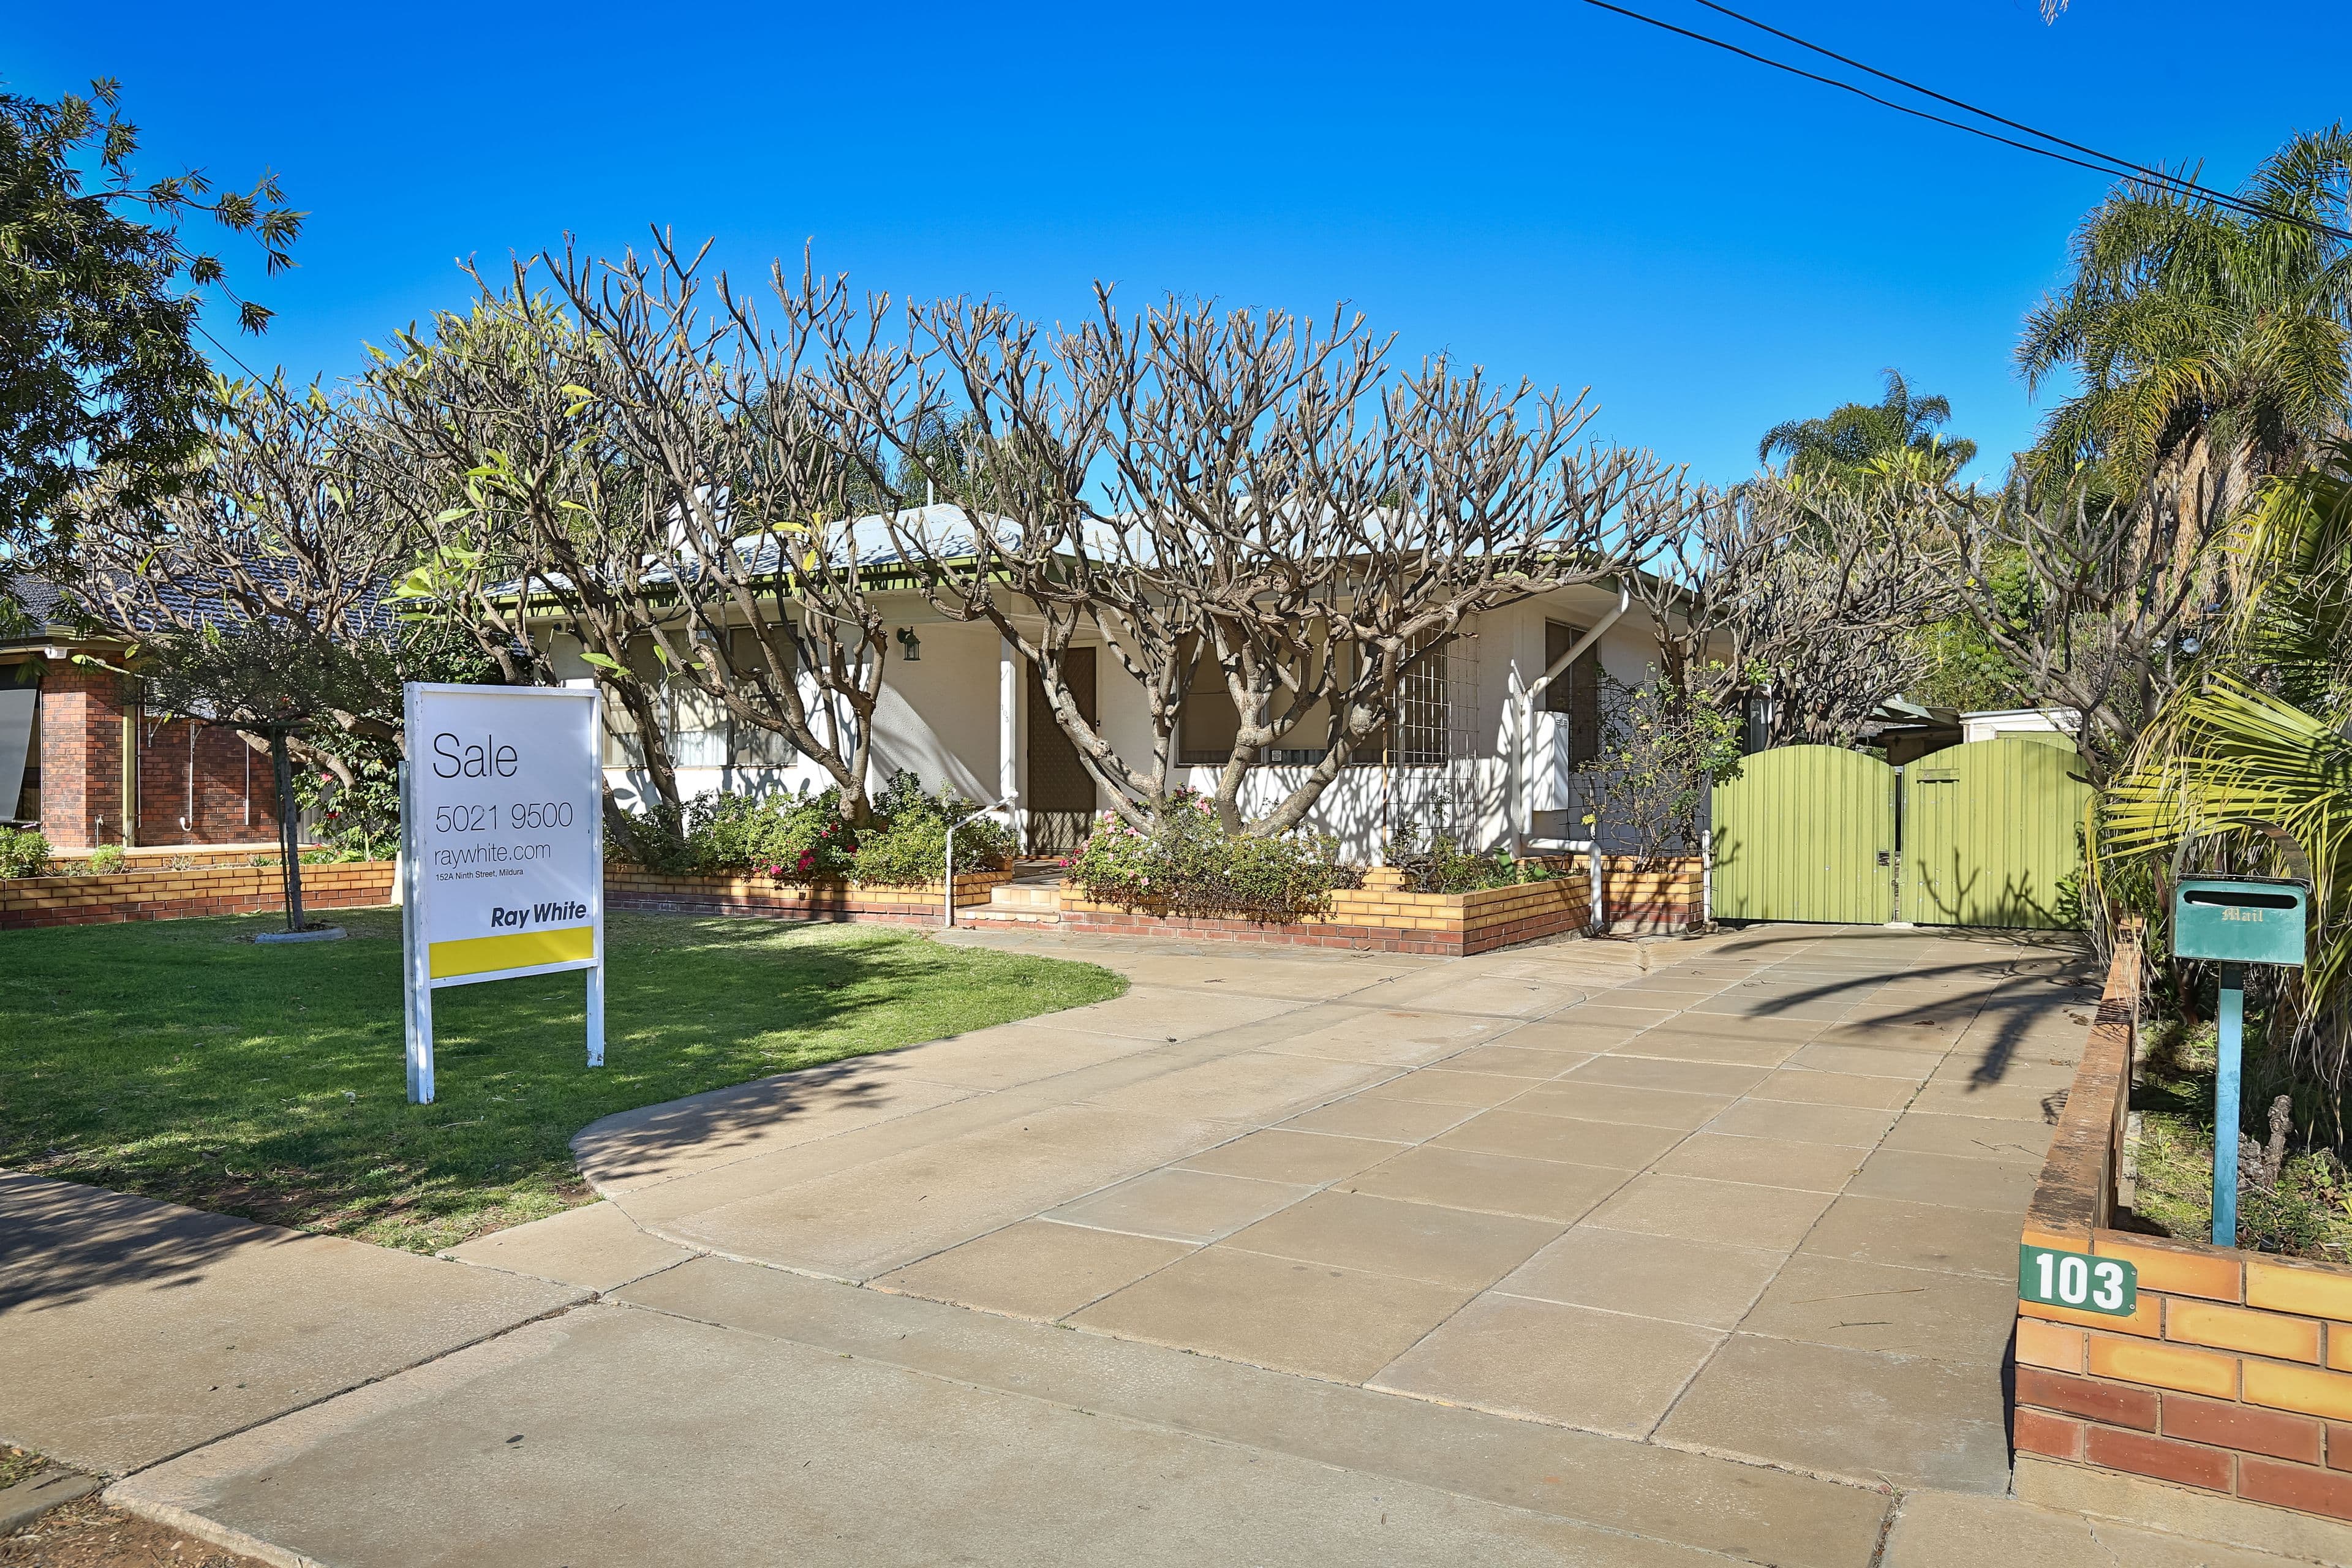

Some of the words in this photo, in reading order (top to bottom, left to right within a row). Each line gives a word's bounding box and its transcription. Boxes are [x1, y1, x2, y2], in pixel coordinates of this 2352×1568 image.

[432, 733, 518, 778] Sale
[435, 804, 497, 833] 5021
[511, 802, 573, 829] 9500
[434, 842, 551, 869] raywhite.com
[435, 873, 454, 881] 152A
[455, 871, 473, 880] Ninth
[475, 870, 497, 878] Street,
[499, 869, 524, 877] Mildura
[491, 907, 530, 929] Ray
[533, 900, 587, 924] White
[2222, 907, 2264, 922] Mail
[2035, 1253, 2124, 1310] 103
